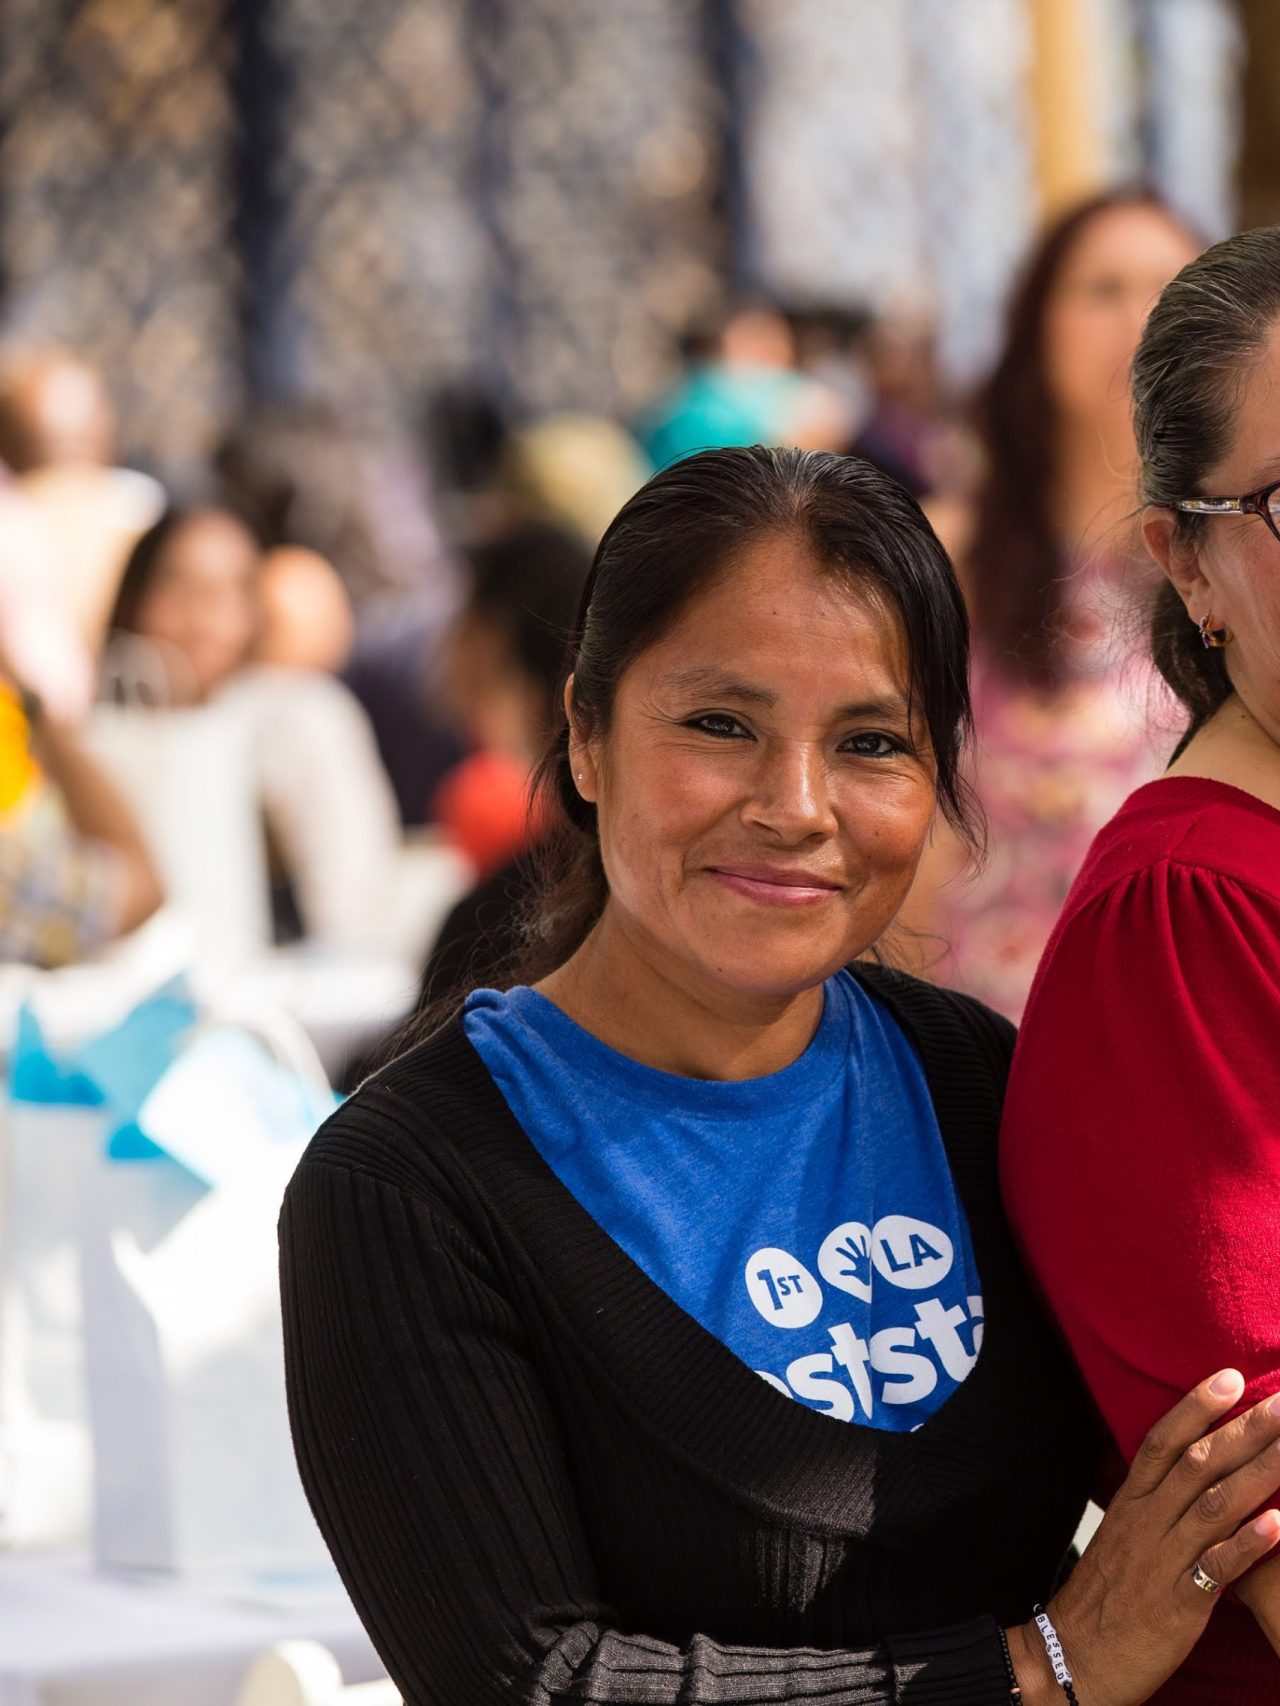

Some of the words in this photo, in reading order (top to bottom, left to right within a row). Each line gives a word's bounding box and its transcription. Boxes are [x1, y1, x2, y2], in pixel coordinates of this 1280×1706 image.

[756, 1268, 804, 1311] 1ST
[880, 1233, 944, 1273] LA
[1037, 1615, 1065, 1680] BLESSED
